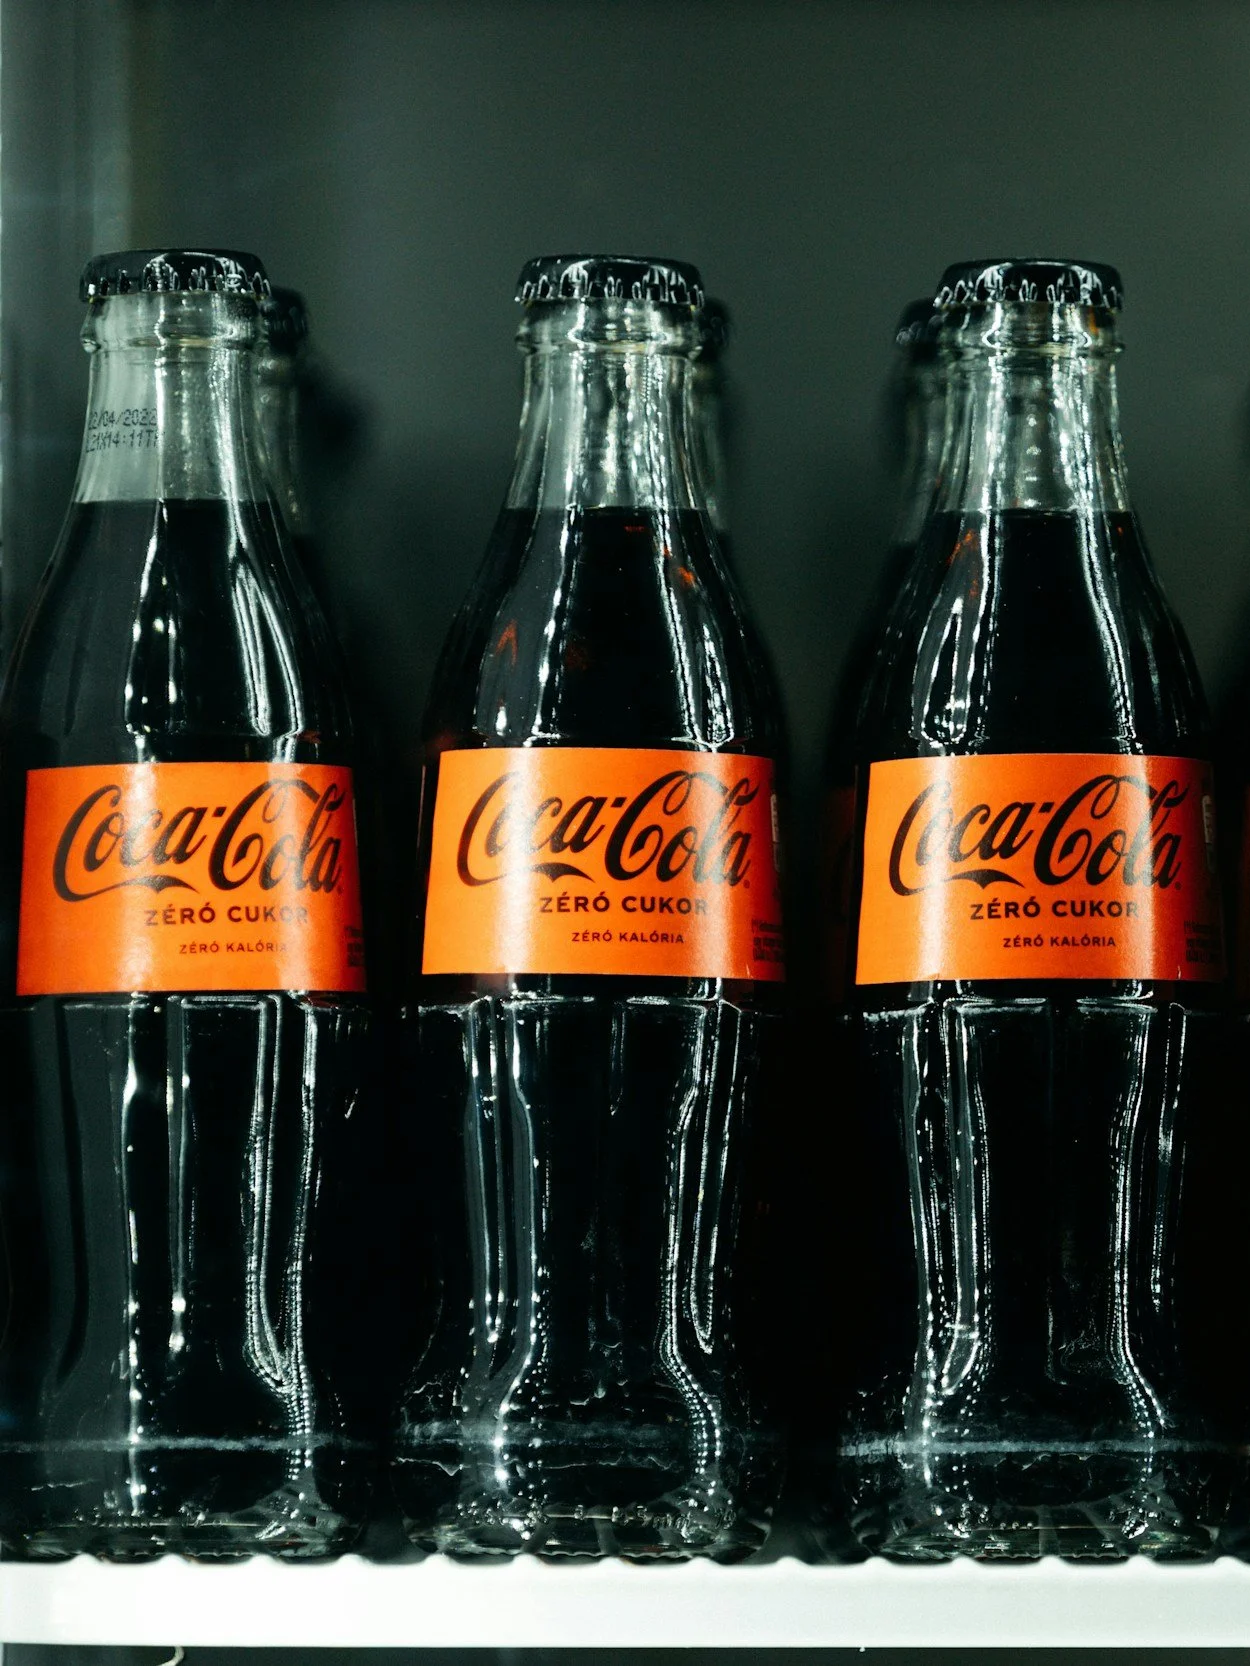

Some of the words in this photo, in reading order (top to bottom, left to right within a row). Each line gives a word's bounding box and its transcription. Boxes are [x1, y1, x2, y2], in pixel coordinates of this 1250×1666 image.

[53, 779, 345, 902] Coca-Cola
[457, 770, 759, 888] Coca-Cola
[889, 774, 1188, 896] Coca-Cola
[145, 902, 216, 926] ZÉRÓ
[227, 906, 307, 924] CUKOR
[539, 891, 611, 914] ZÉRÓ
[621, 895, 709, 915] CUKOR
[970, 896, 1041, 920] ZÉRÓ
[1051, 899, 1139, 918] CUKOR
[179, 940, 219, 954] ZÉRÓ
[572, 929, 613, 942] ZÉRÓ
[619, 929, 684, 943] KALÓRIA
[1003, 934, 1043, 947] ZÉRÓ
[1050, 933, 1116, 947] KALÓRIA
